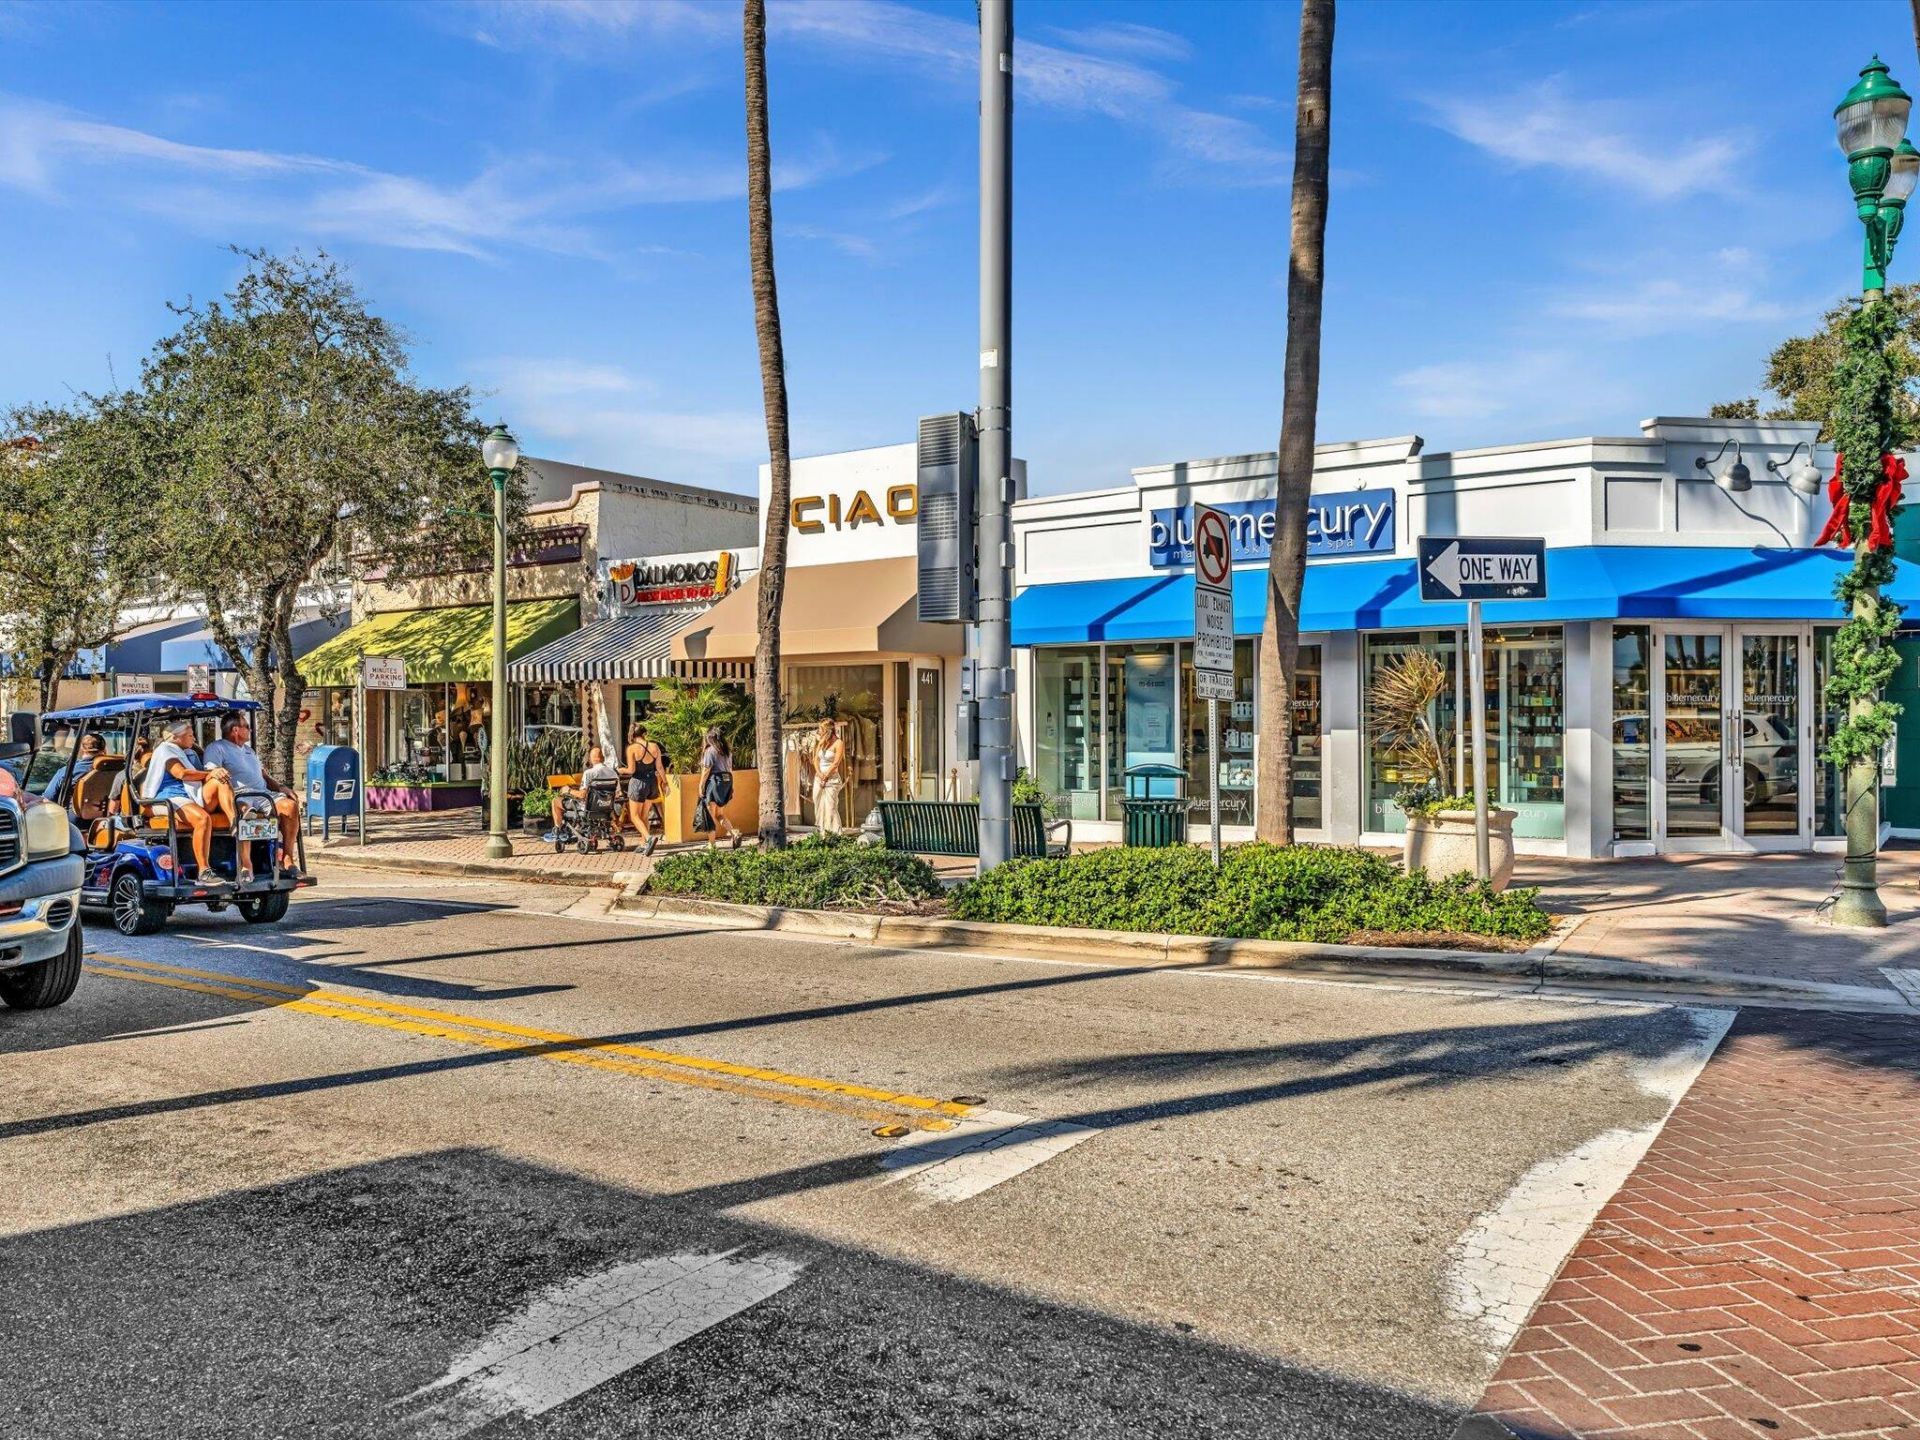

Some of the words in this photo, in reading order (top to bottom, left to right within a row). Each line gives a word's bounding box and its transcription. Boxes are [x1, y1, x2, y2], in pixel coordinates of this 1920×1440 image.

[791, 484, 918, 531] CIAO
[1150, 502, 1388, 547] blumecury
[1328, 538, 1354, 551] spa
[634, 560, 719, 586] DALMOROS
[1459, 557, 1494, 581] ONE
[1499, 557, 1533, 580] WAY
[1196, 592, 1209, 609] LOUD
[1212, 596, 1231, 614] EXHAUST
[1206, 613, 1224, 630] NOISE
[1197, 631, 1232, 651] PROHIBITED
[382, 659, 388, 668] 5
[370, 673, 403, 681] PARKING
[371, 667, 398, 675] MINUTES
[921, 671, 933, 685] 441
[1199, 673, 1207, 684] OR
[1208, 674, 1233, 687] TRAILERS
[1666, 692, 1719, 704] bluemercury
[1743, 693, 1797, 705] bluemercury
